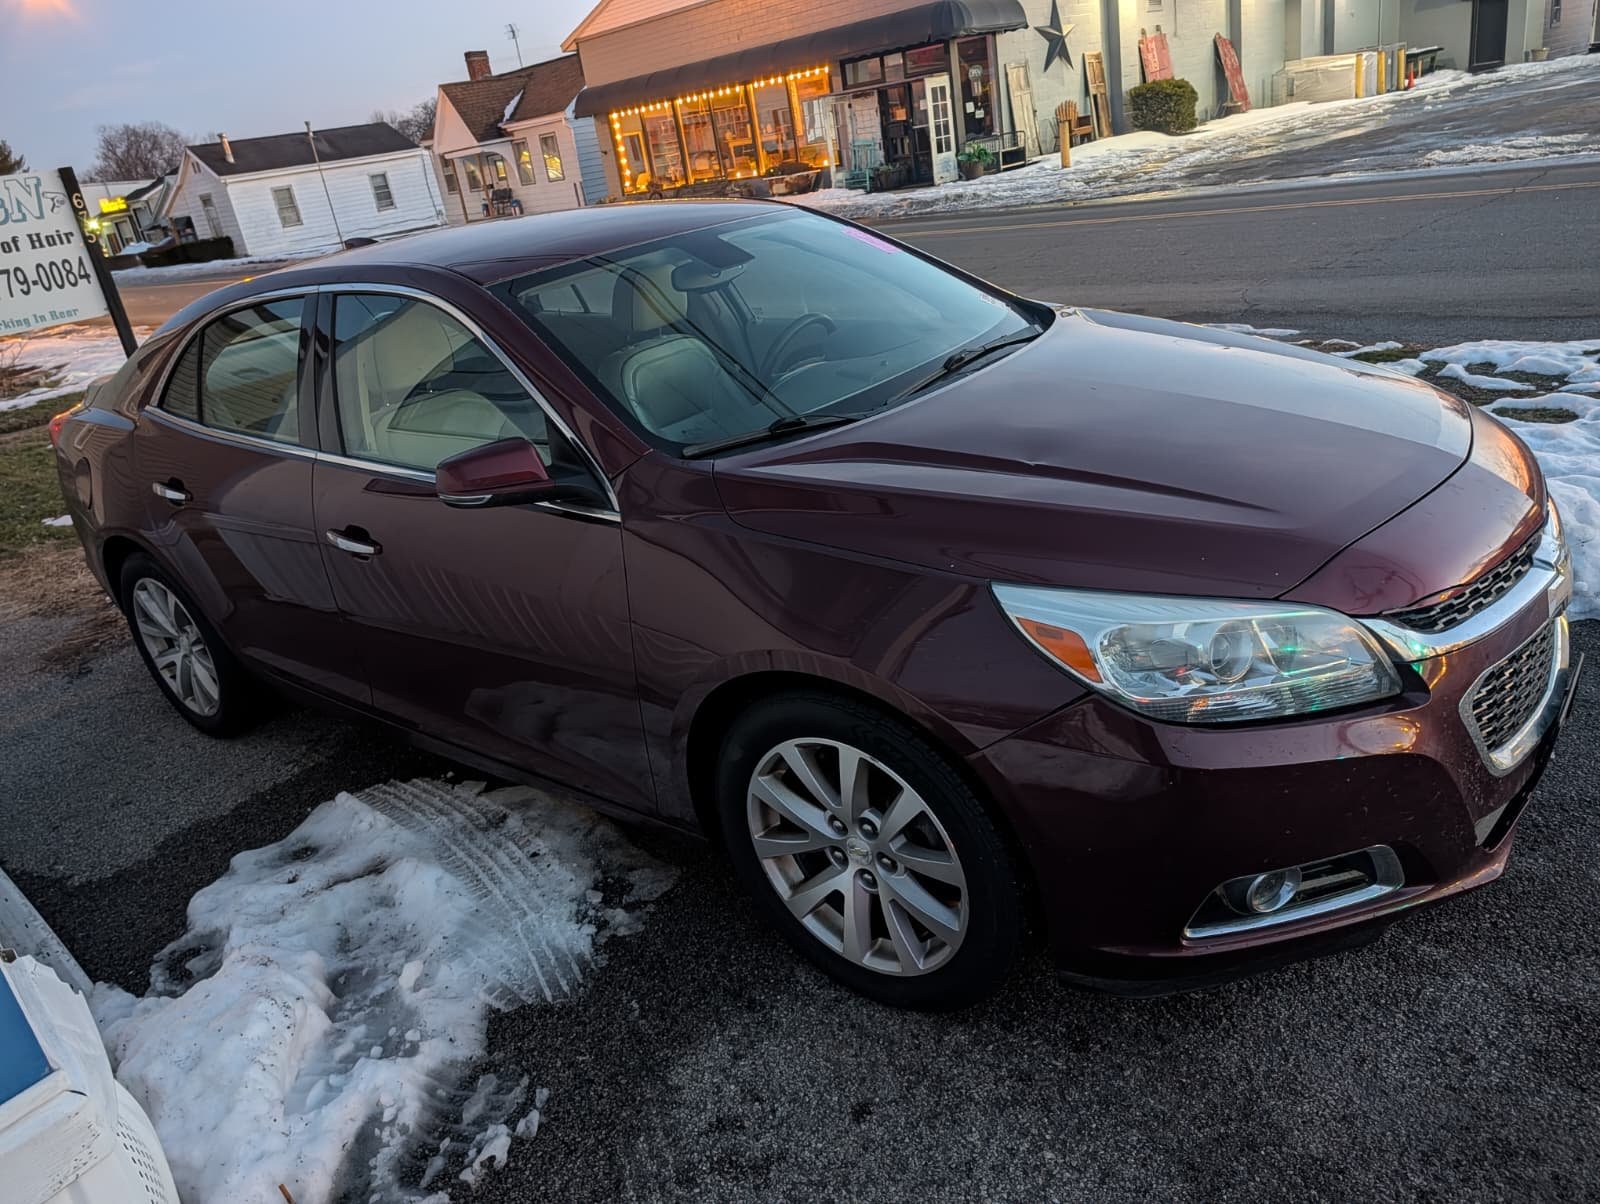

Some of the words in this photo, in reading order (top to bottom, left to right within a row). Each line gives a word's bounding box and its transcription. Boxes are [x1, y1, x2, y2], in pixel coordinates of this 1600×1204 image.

[0, 176, 45, 225] N
[0, 236, 20, 254] of
[26, 229, 74, 250] Hair
[0, 256, 91, 298] 79-0084
[33, 313, 47, 323] In
[48, 308, 79, 321] Rear
